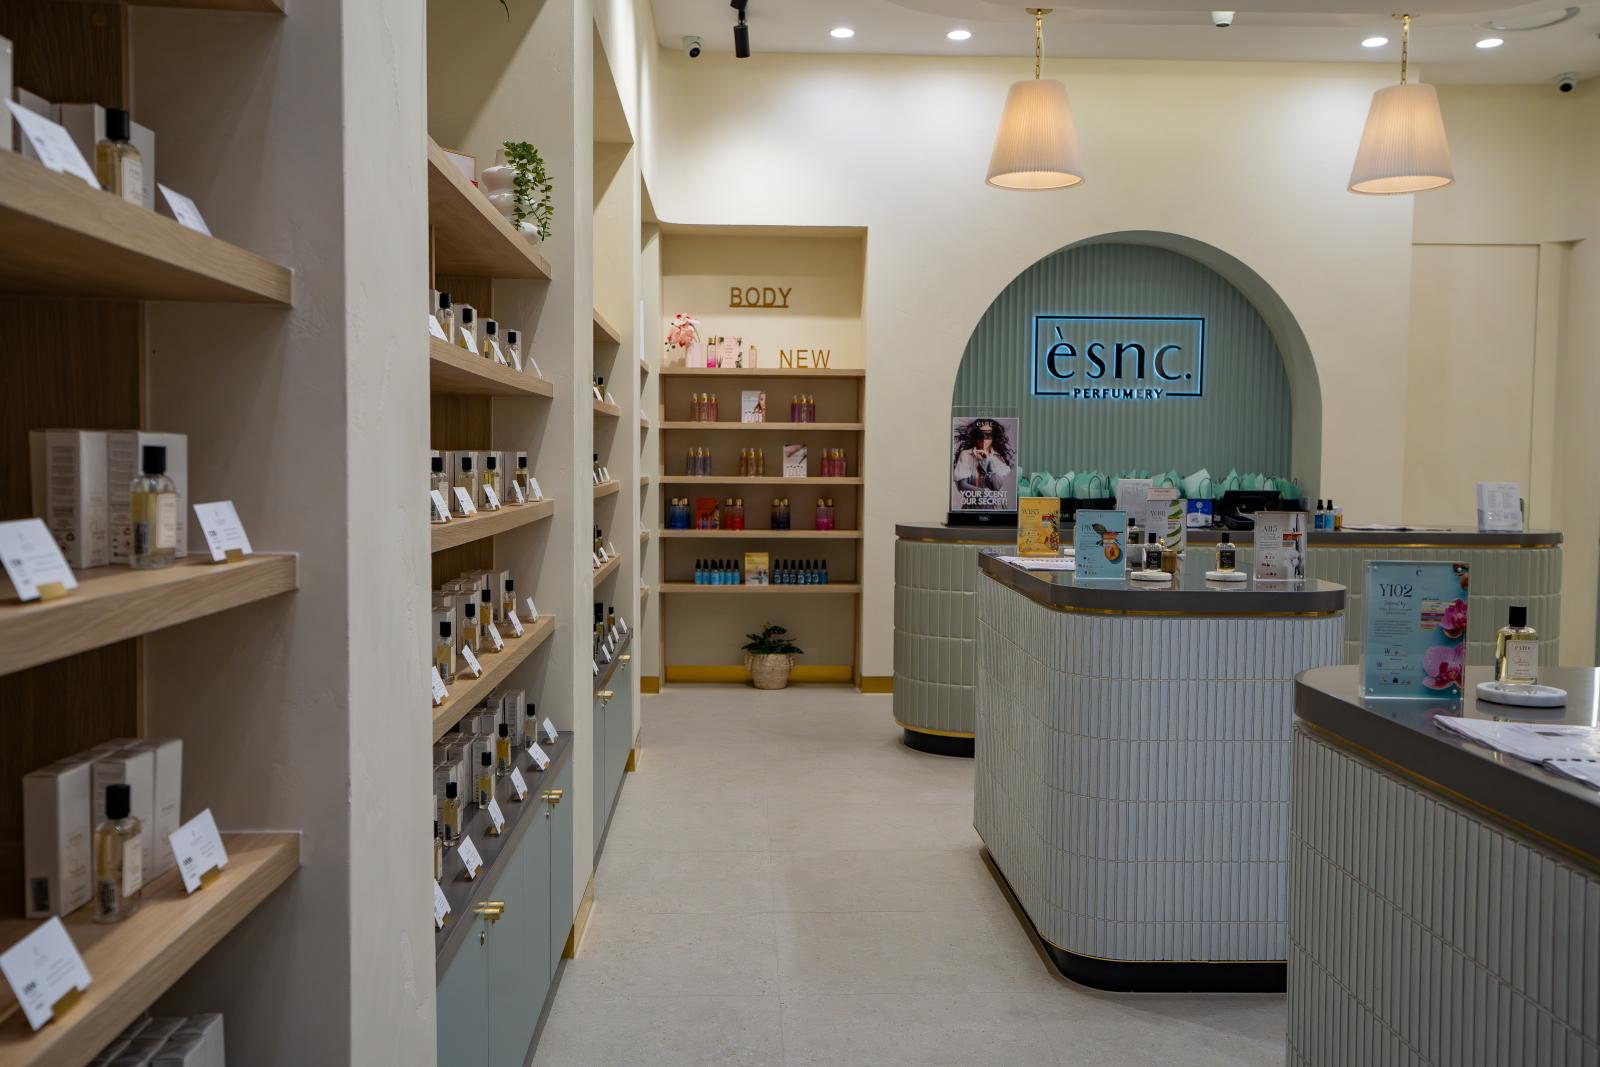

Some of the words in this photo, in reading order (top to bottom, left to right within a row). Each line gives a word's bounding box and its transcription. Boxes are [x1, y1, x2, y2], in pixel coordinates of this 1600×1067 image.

[730, 287, 792, 306] BODY
[779, 350, 831, 368] NEW
[1073, 388, 1164, 399] PERFUMERY
[960, 490, 982, 498] YOUR
[983, 490, 1008, 498] SCENT
[960, 497, 976, 505] OUR
[977, 497, 1008, 505] SECRET!
[1379, 583, 1413, 598] Y102
